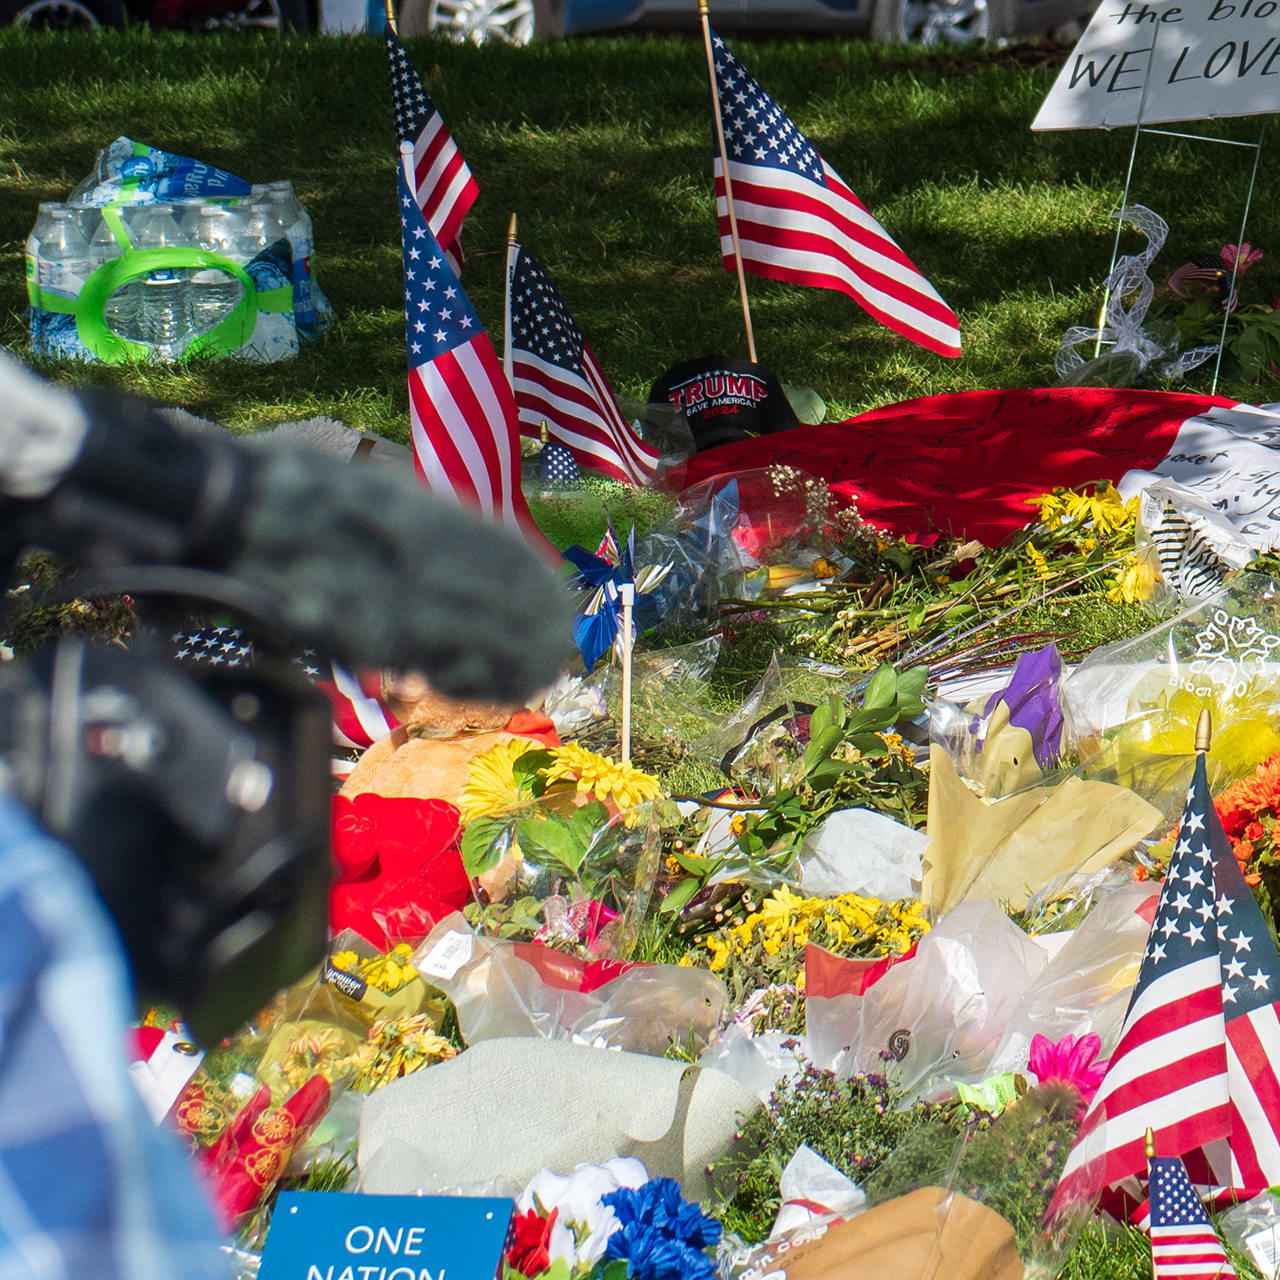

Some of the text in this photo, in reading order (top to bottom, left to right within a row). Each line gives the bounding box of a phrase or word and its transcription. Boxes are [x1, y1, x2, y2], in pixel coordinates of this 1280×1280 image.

[1109, 3, 1184, 26] the
[1068, 46, 1156, 94] WE
[668, 375, 768, 413] TRUMP
[686, 396, 757, 417] SAVE AMERICA!
[702, 404, 740, 420] 2024
[345, 1225, 426, 1256] ONE
